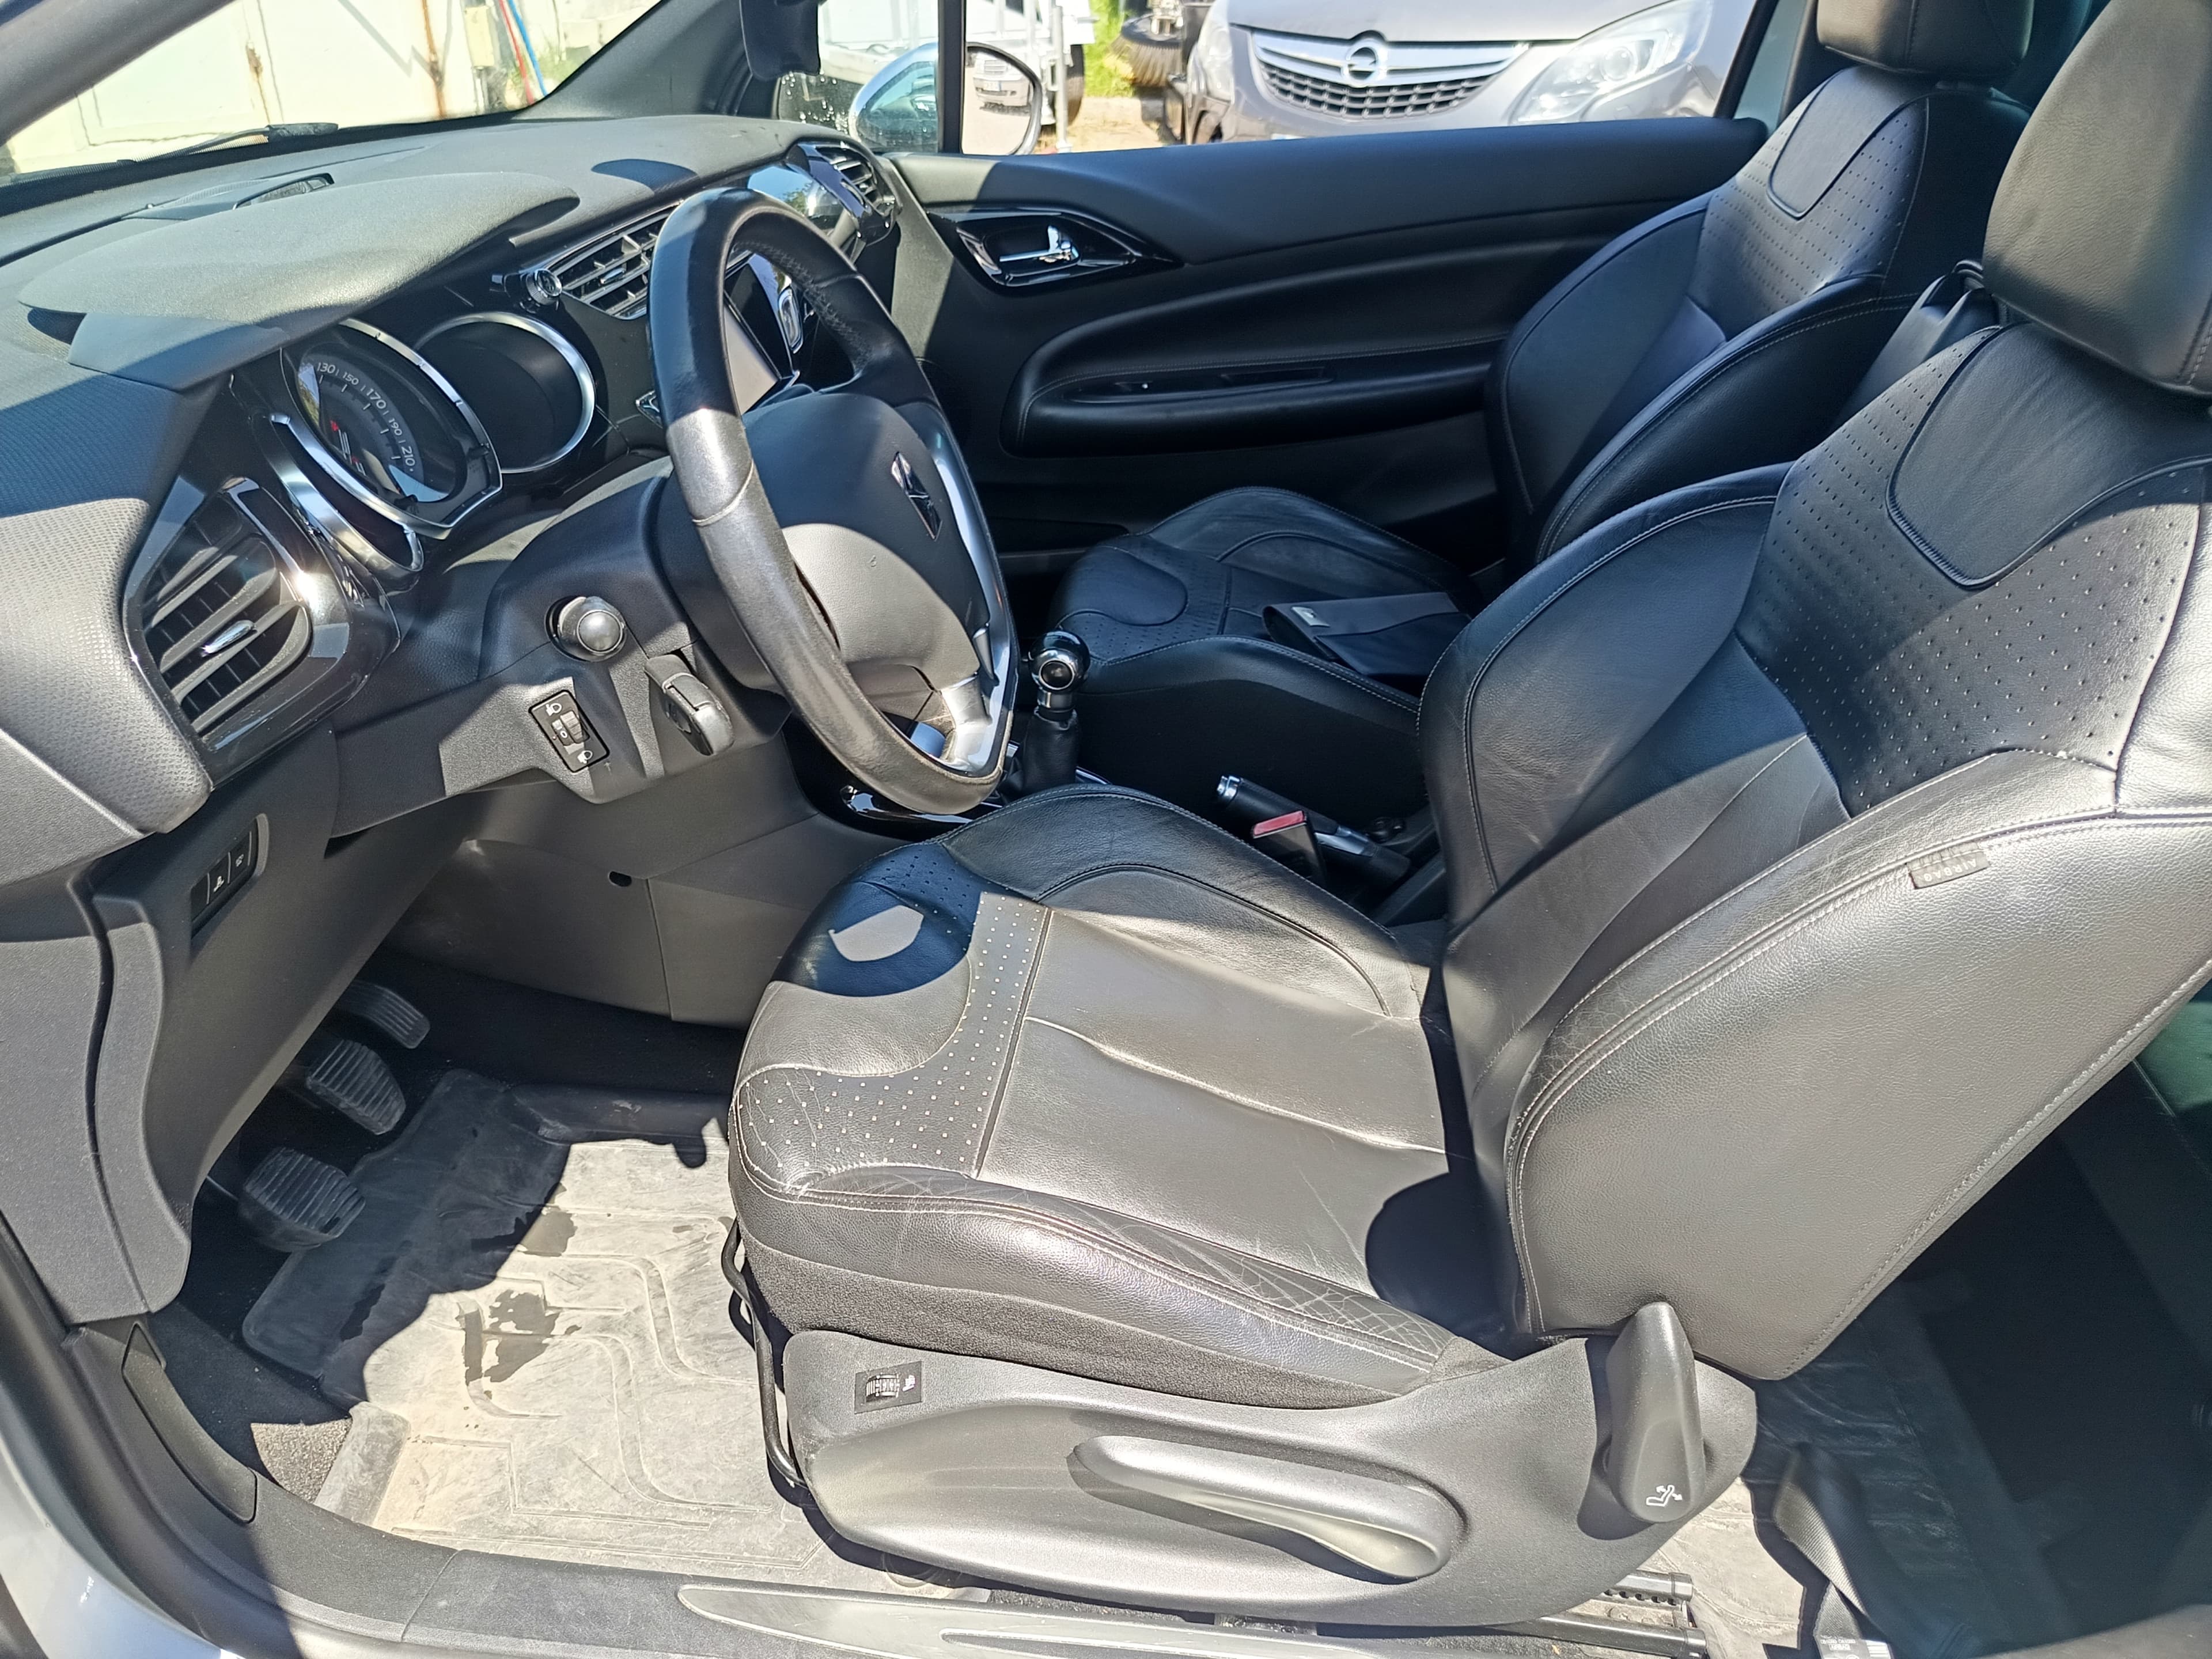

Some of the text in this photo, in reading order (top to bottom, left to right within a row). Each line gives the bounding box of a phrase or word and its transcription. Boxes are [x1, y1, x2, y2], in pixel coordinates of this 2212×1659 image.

[317, 362, 415, 466] 130 150 170 190 210
[560, 730, 568, 738] 0
[1923, 858, 1976, 882] AIRBAG
